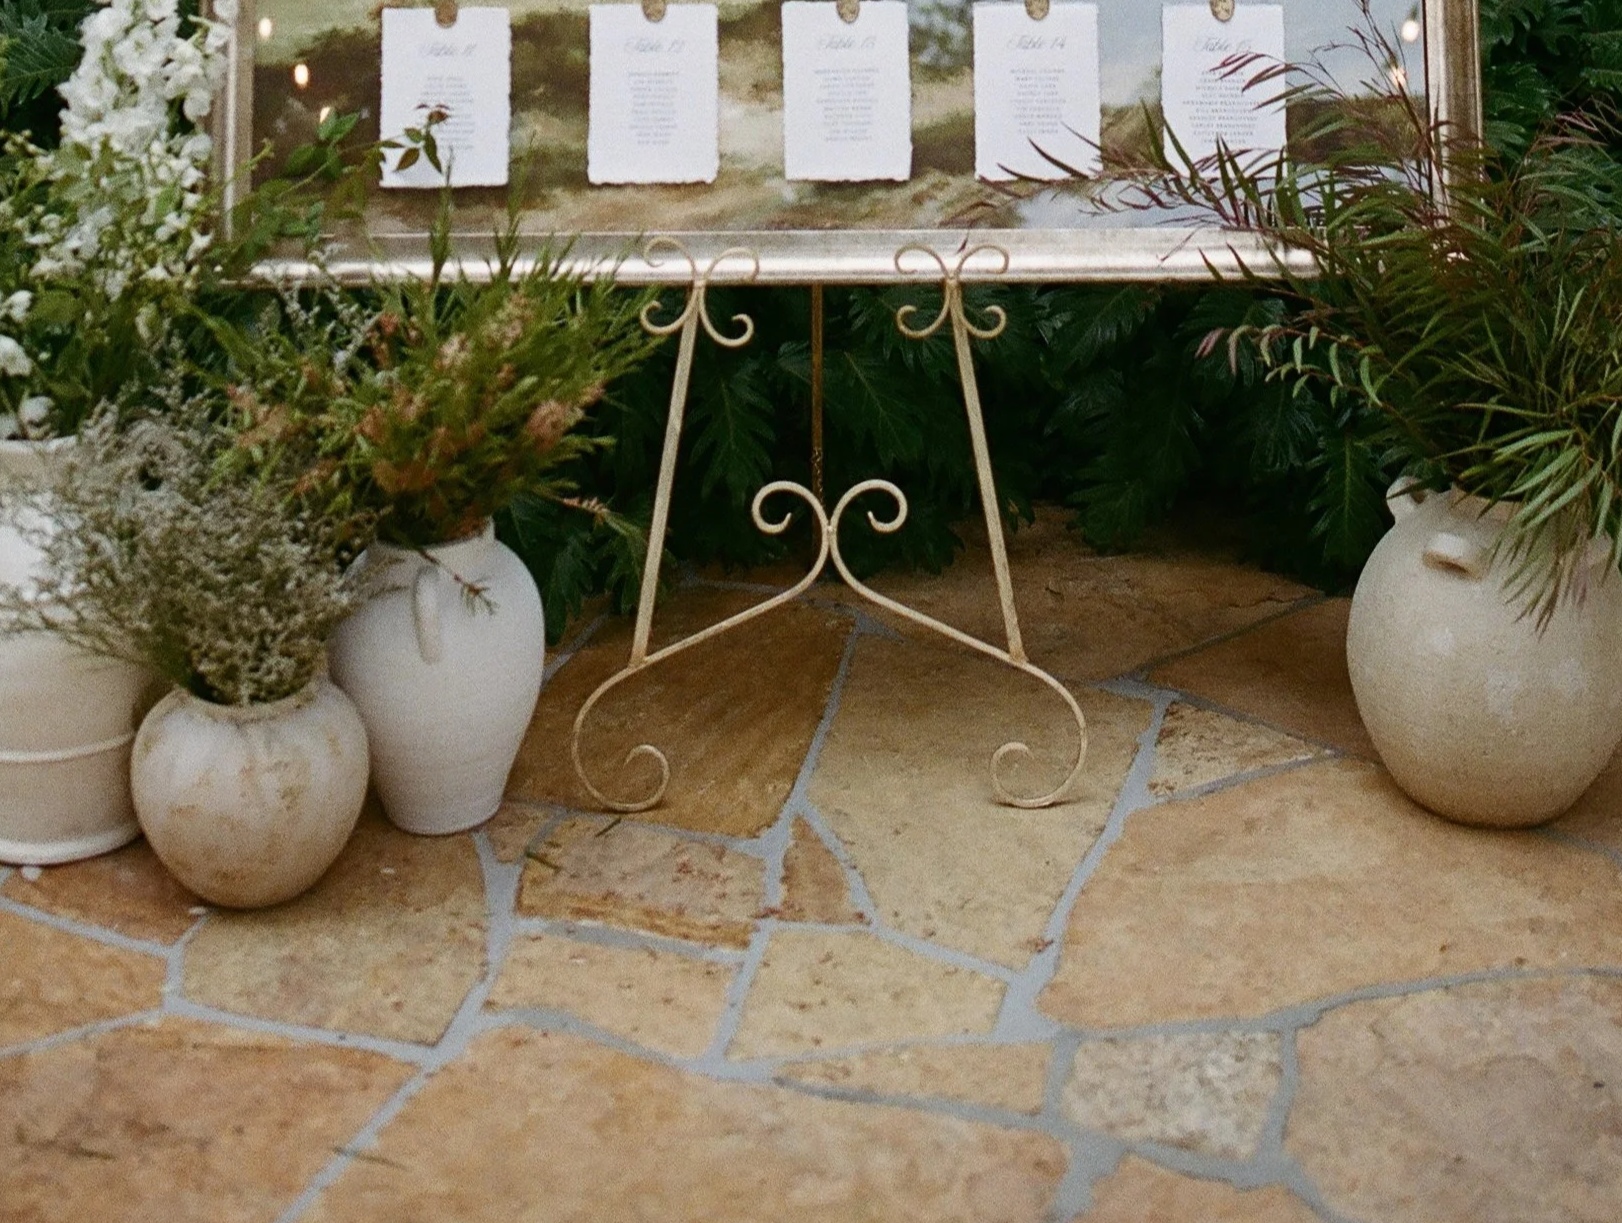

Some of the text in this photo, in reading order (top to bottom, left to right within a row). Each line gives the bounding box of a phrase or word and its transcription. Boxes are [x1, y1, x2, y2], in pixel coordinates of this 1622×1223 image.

[625, 38, 663, 51] Table
[818, 36, 855, 49] Table
[1008, 36, 1067, 49] Table 14
[1194, 38, 1230, 51] Table
[419, 44, 457, 57] Table
